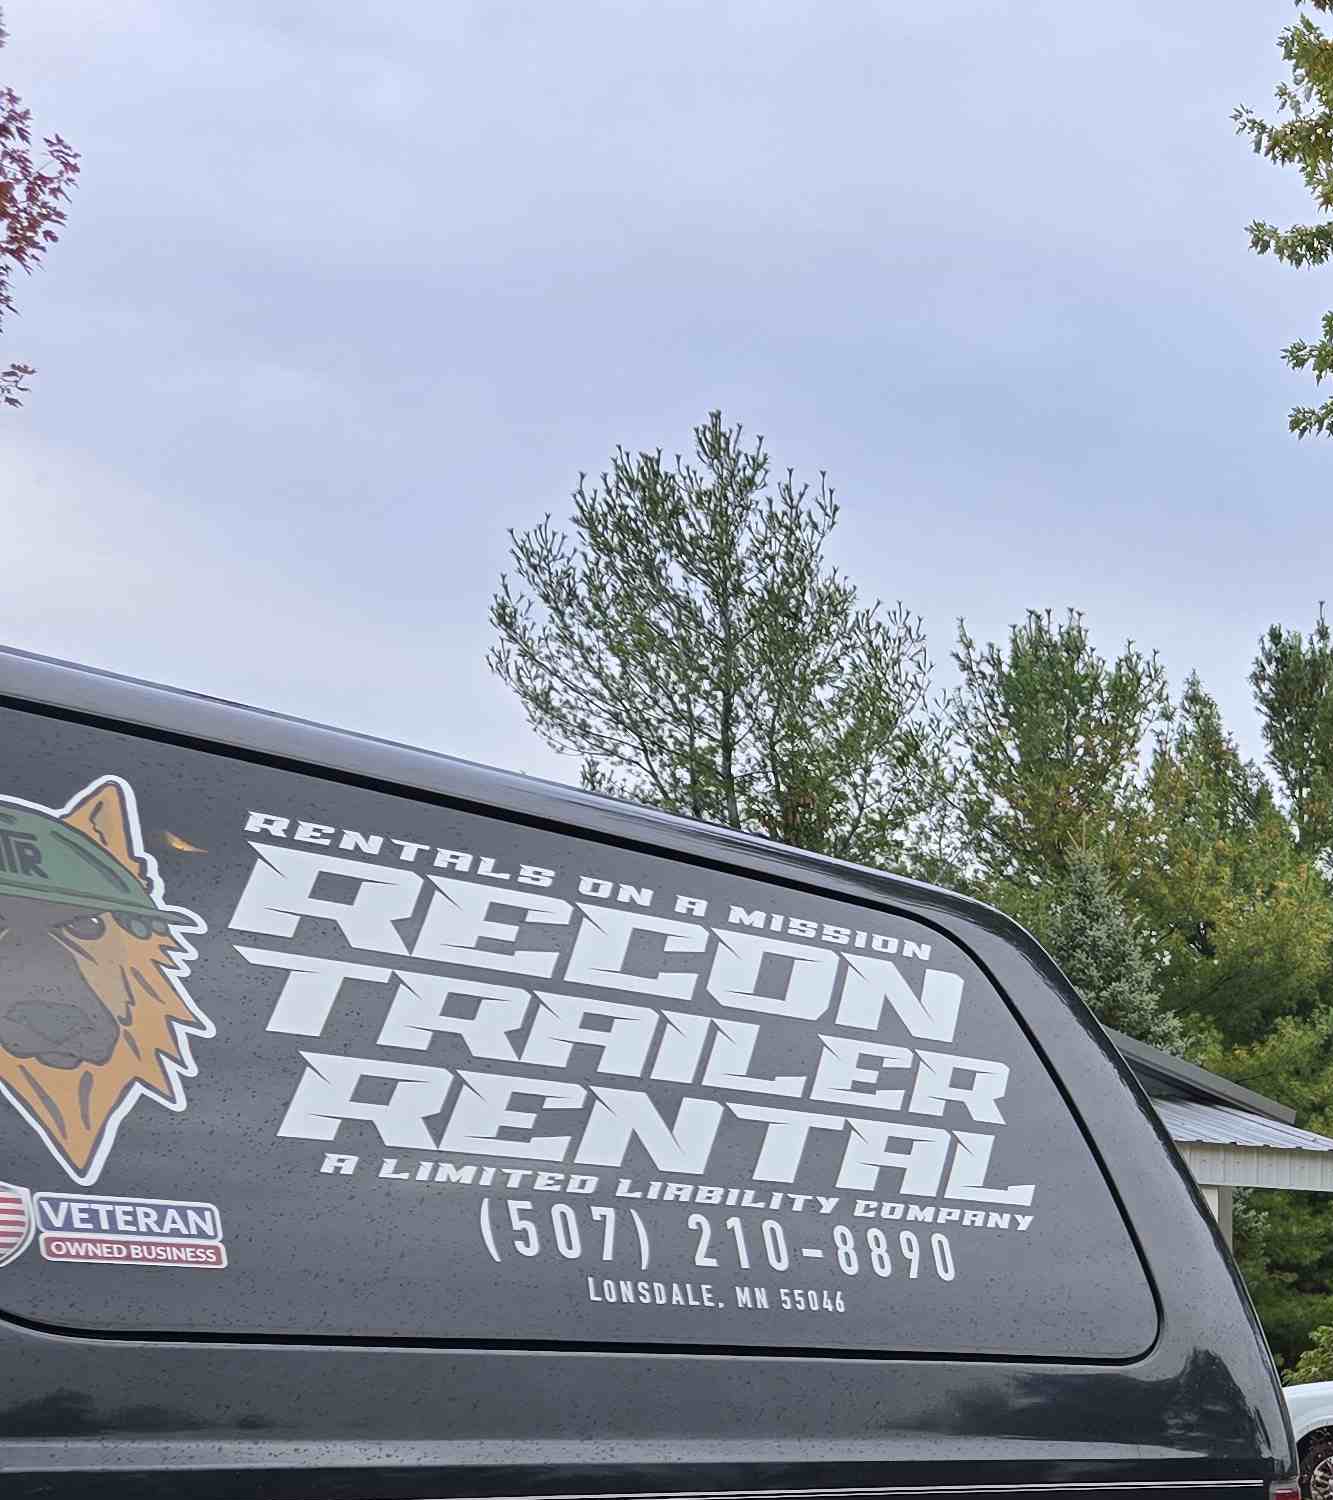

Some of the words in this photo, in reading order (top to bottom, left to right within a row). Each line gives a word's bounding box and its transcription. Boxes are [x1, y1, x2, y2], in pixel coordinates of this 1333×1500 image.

[244, 810, 556, 887] RENTALS
[578, 874, 654, 908] ON
[676, 895, 707, 917] A
[728, 905, 931, 961] MISSION
[227, 841, 965, 1043] RECON
[232, 945, 1010, 1125] TRAILER
[276, 1050, 1036, 1207] RENTAL
[40, 1199, 215, 1236] VETERAN
[320, 1152, 360, 1176] A
[379, 1158, 598, 1195] LIMITED
[616, 1178, 841, 1214] LIABILITY
[854, 1199, 1035, 1231] COMPANY
[51, 1241, 128, 1258] OWNED
[131, 1244, 217, 1262] BUSINESS
[480, 1198, 650, 1270] (507)
[688, 1214, 957, 1282] 210-8890
[737, 1288, 770, 1309] MN
[780, 1290, 846, 1312] 55046
